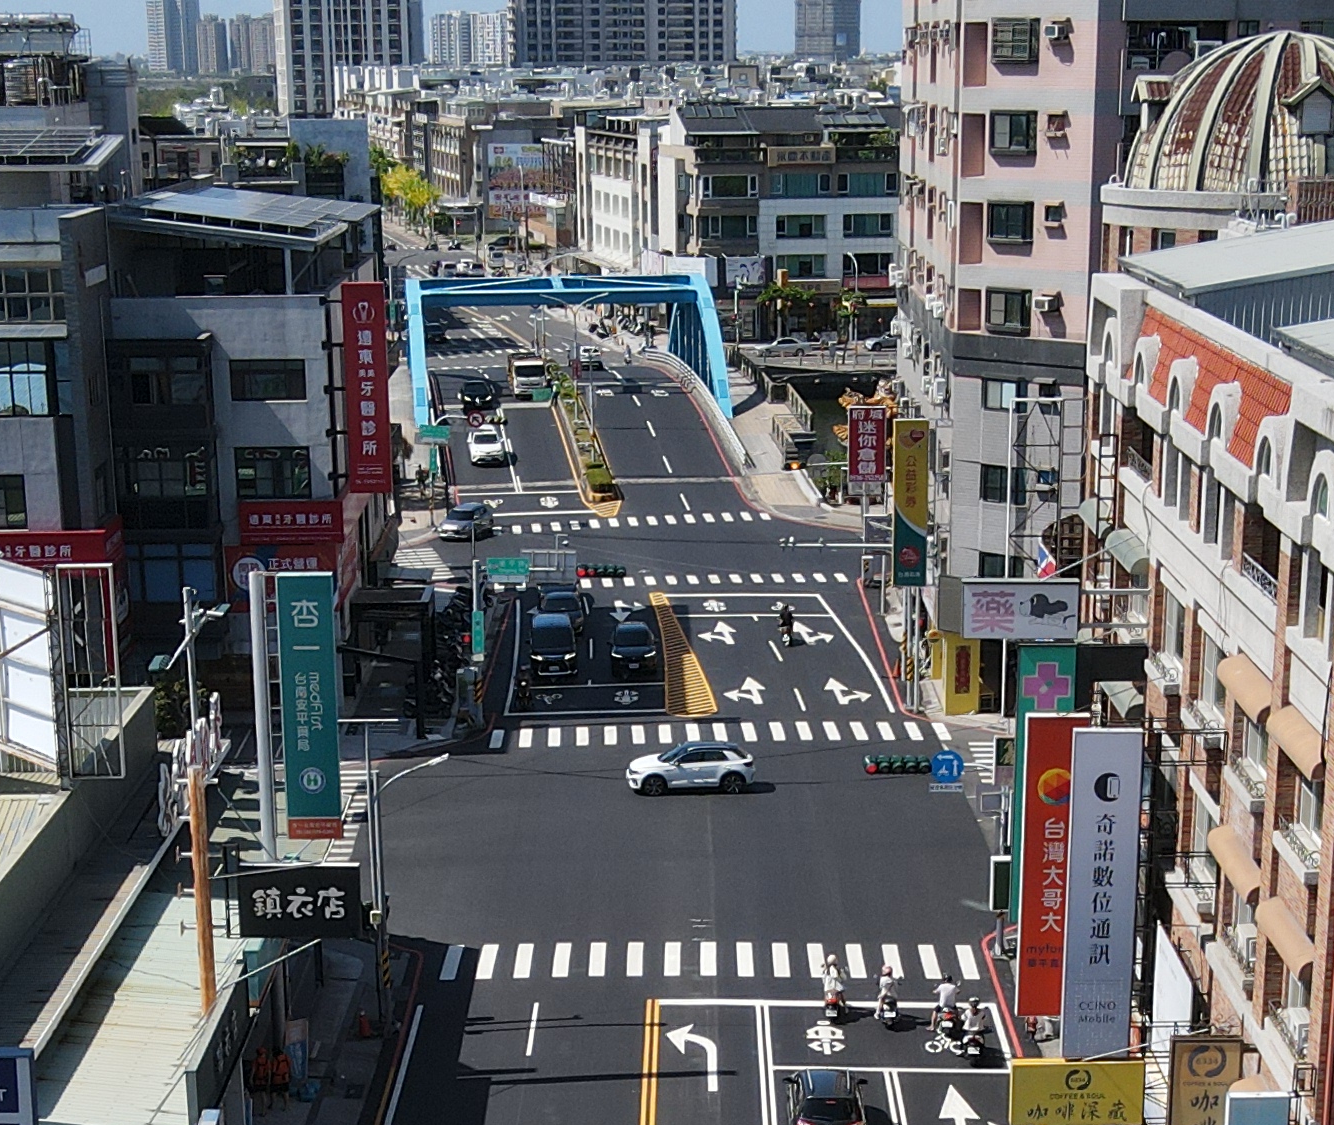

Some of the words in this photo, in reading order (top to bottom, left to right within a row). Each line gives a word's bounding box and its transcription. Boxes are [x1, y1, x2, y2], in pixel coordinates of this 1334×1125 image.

[290, 600, 320, 650] 杏一
[971, 590, 1015, 633] 藥
[1040, 818, 1066, 932] 台灣大哥大
[1089, 814, 1116, 965] 奇諾數位通訊
[252, 887, 345, 919] 鎮衣店
[1027, 1100, 1127, 1122] 咖啡深藏
